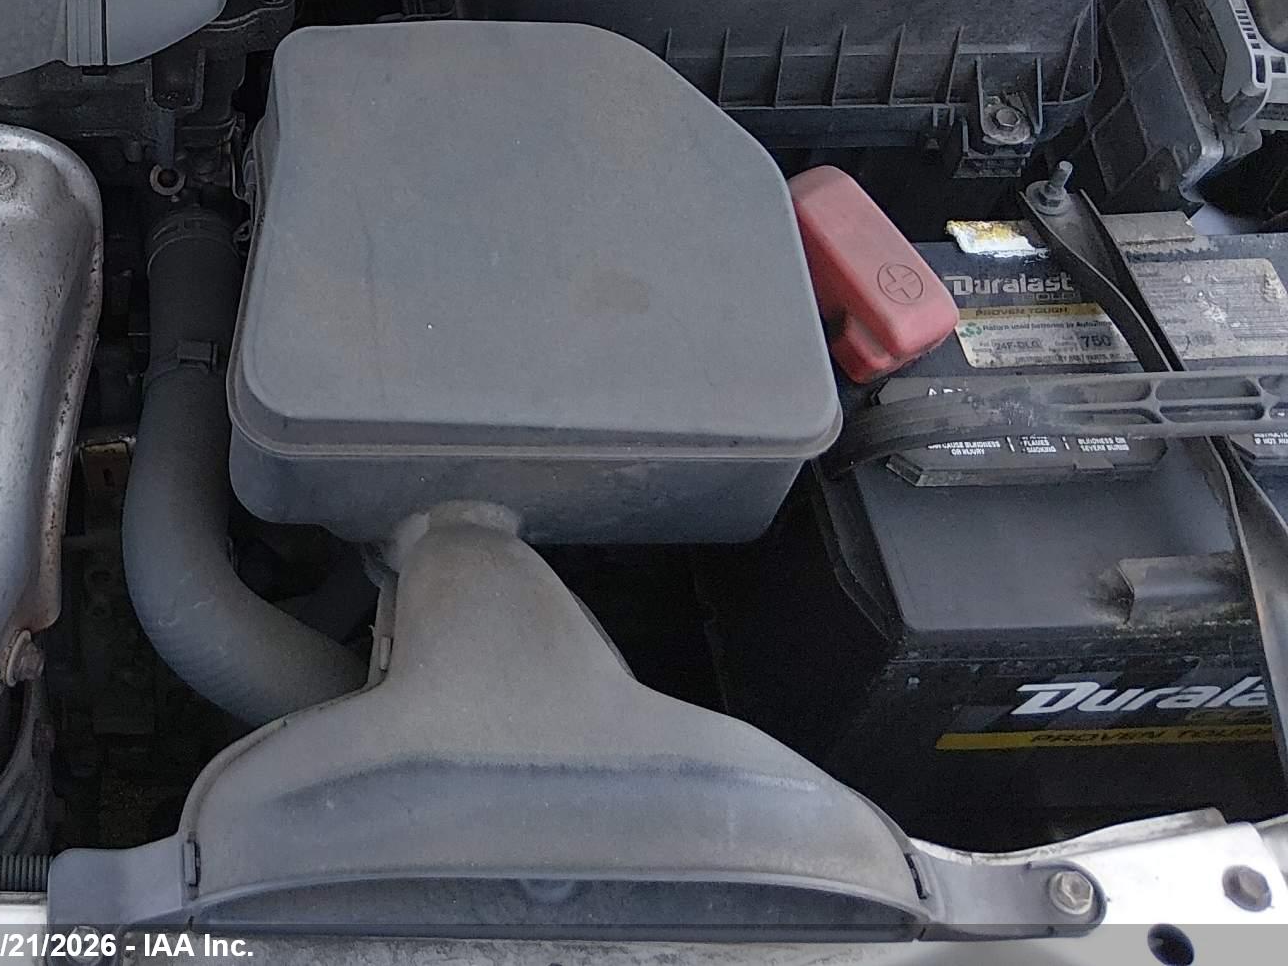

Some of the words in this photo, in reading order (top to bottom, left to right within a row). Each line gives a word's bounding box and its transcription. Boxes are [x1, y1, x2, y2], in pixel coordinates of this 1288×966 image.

[943, 272, 1074, 297] Duralast
[975, 307, 1025, 317] PROVEN
[1028, 305, 1068, 315] TOUGH
[983, 323, 1010, 332] Return
[1080, 335, 1112, 348] 750
